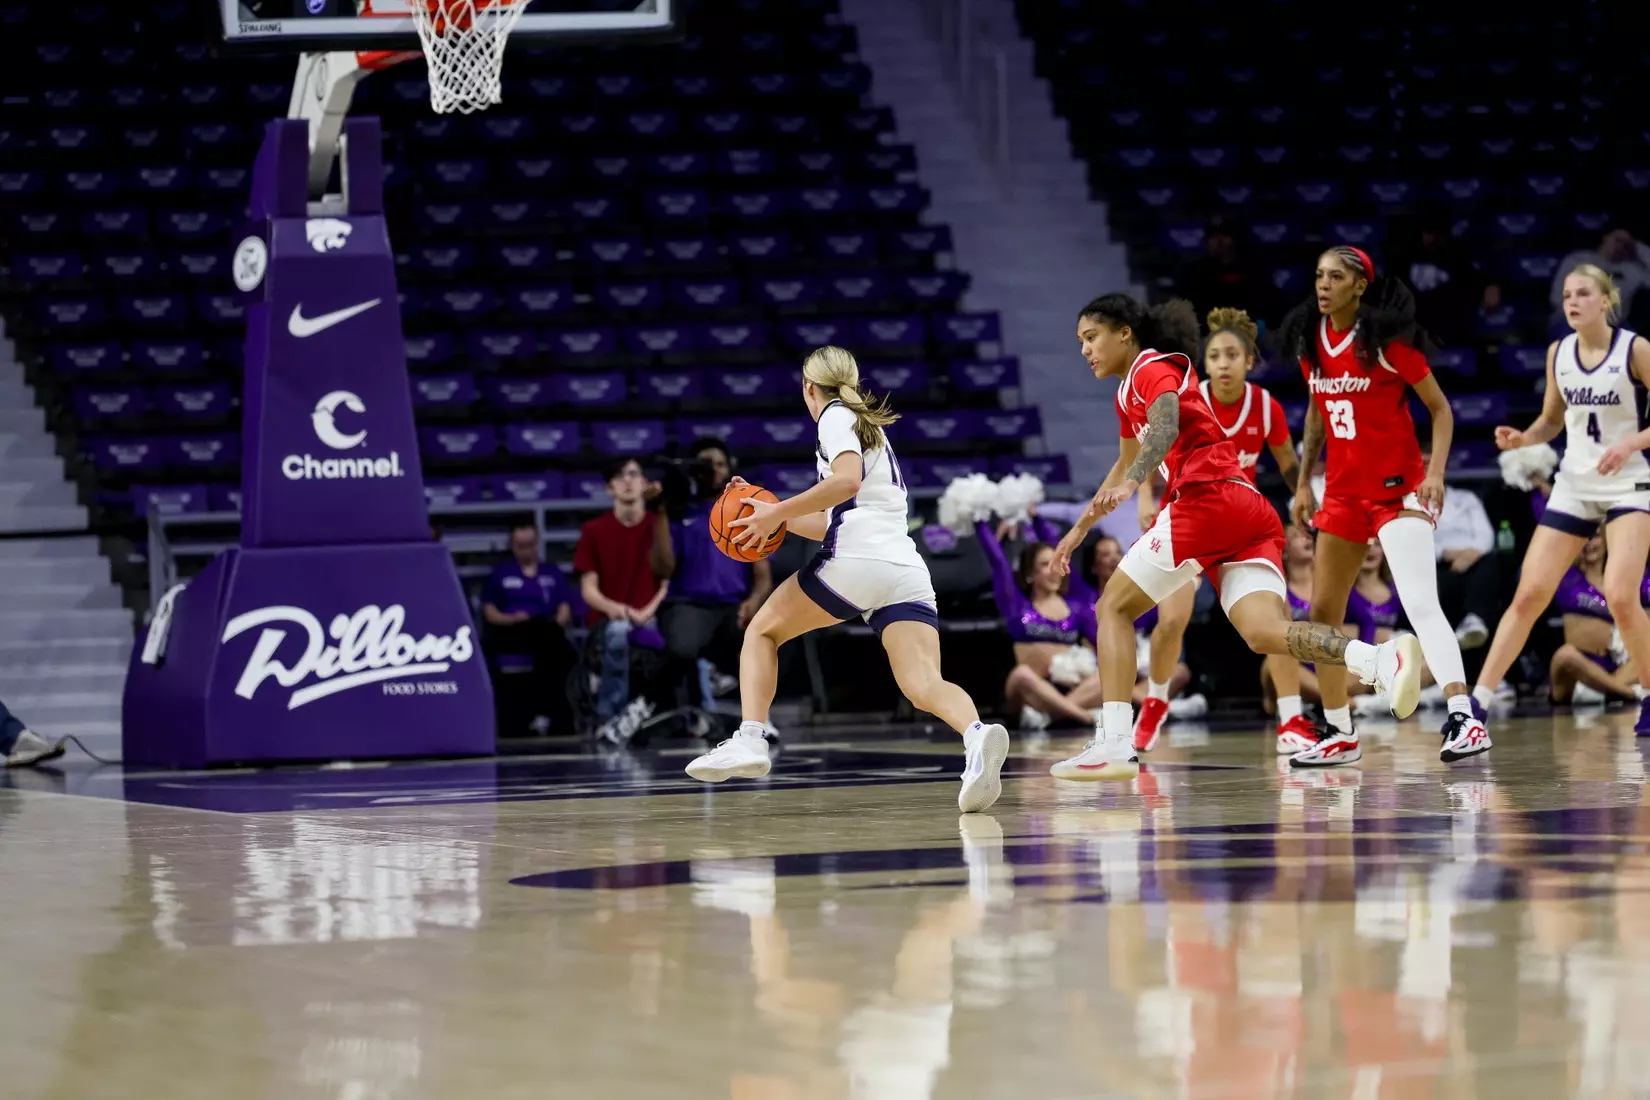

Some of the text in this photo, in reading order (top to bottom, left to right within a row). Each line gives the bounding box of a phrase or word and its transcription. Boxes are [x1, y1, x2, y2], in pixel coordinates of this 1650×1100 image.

[1308, 367, 1371, 395] Houston
[1564, 387, 1621, 406] Wildcats
[1325, 399, 1357, 440] 23
[1586, 411, 1602, 444] 4
[281, 450, 402, 481] Channel
[221, 604, 473, 701] Dillons
[382, 681, 458, 696] FOOD STORES
